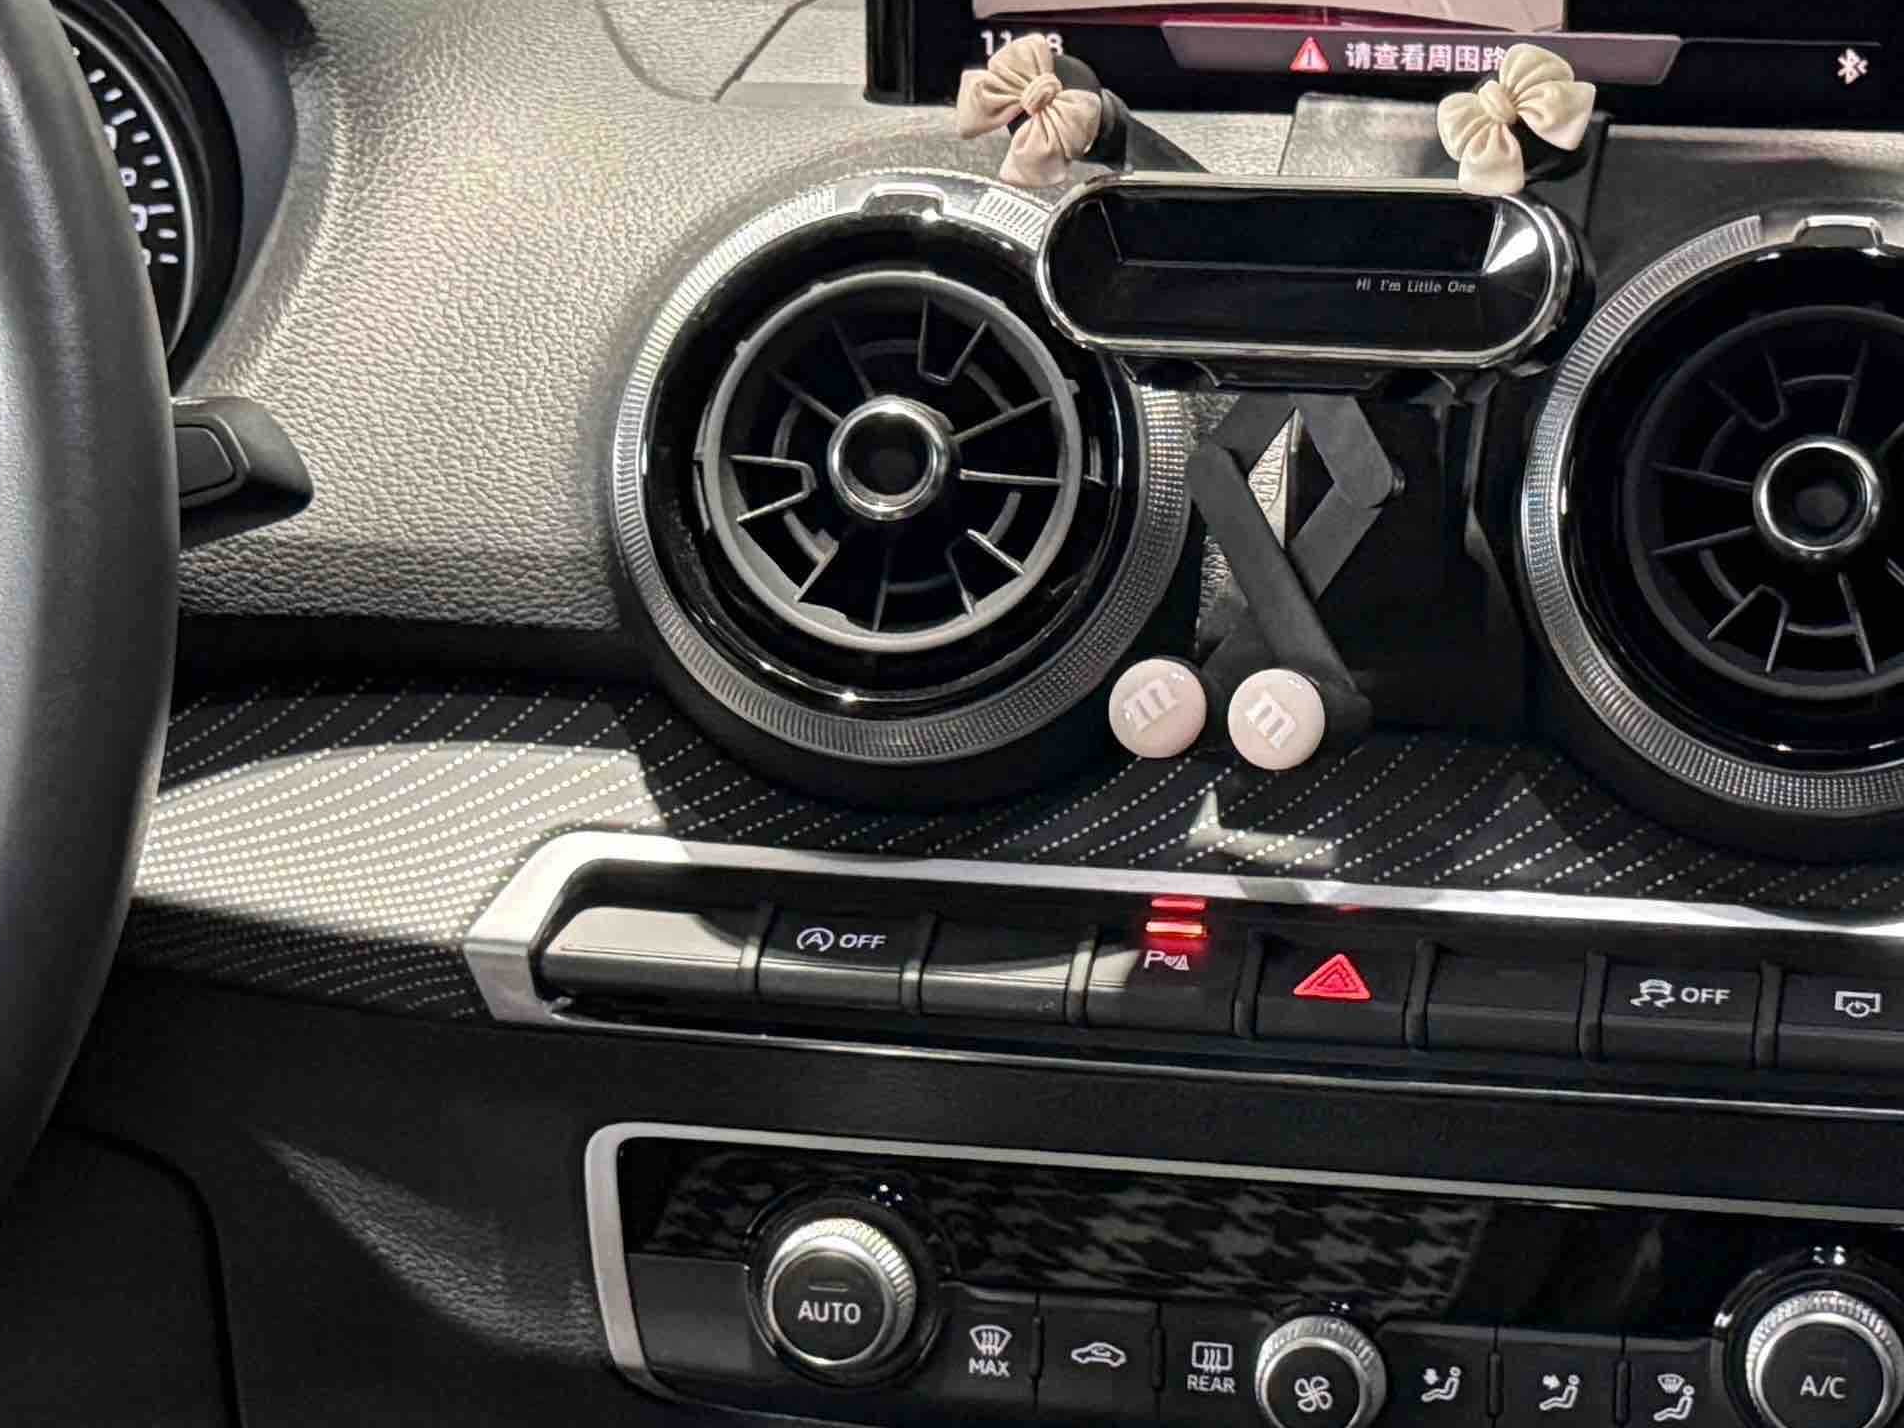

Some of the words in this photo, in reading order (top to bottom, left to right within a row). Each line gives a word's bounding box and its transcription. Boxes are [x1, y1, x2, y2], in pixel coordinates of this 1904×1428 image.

[839, 933, 888, 950] OFF
[1680, 986, 1732, 1005] OFF
[797, 1299, 862, 1324] AUTO
[968, 1357, 1011, 1377] MAX
[1187, 1373, 1236, 1394] REAR
[1799, 1374, 1847, 1400] A/C
